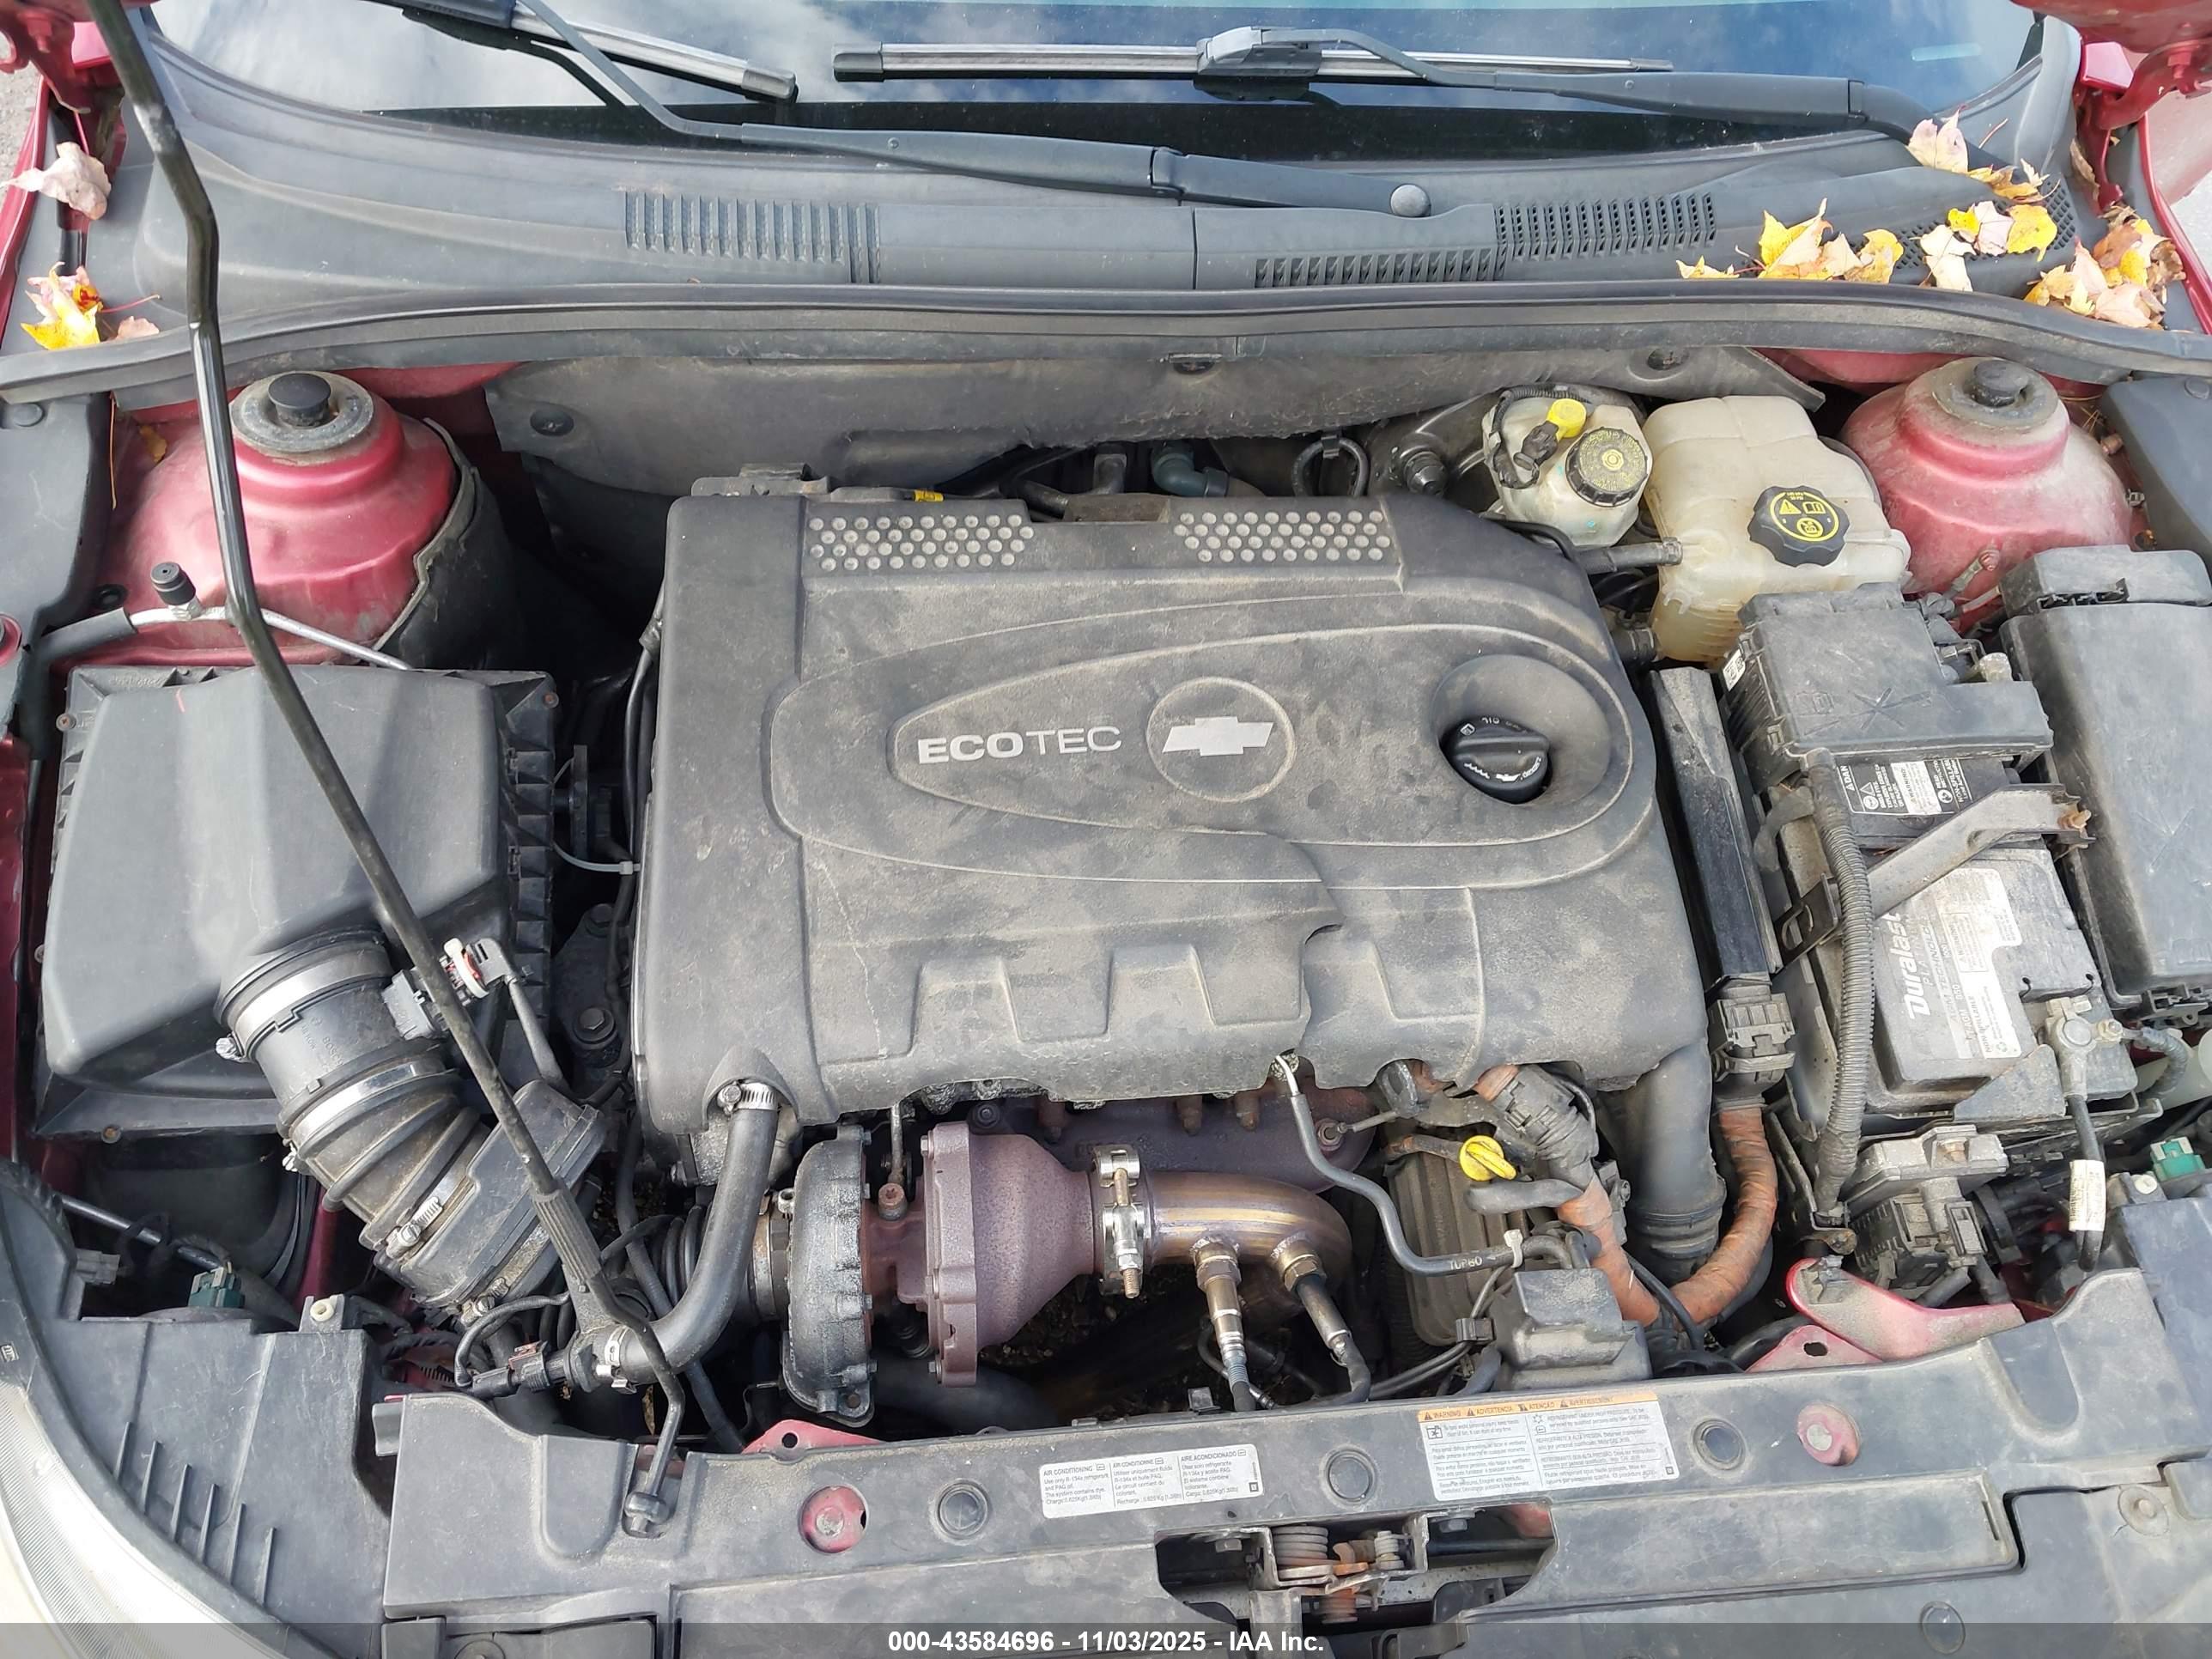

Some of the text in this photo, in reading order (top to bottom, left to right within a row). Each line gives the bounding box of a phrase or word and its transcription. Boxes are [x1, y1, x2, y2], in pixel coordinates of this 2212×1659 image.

[918, 726, 1122, 764] ECOTEC
[1882, 913, 1930, 1019] Duralast
[1194, 1451, 1237, 1461] ACONDICIONADO
[1054, 1466, 1092, 1475] CONDITIONING
